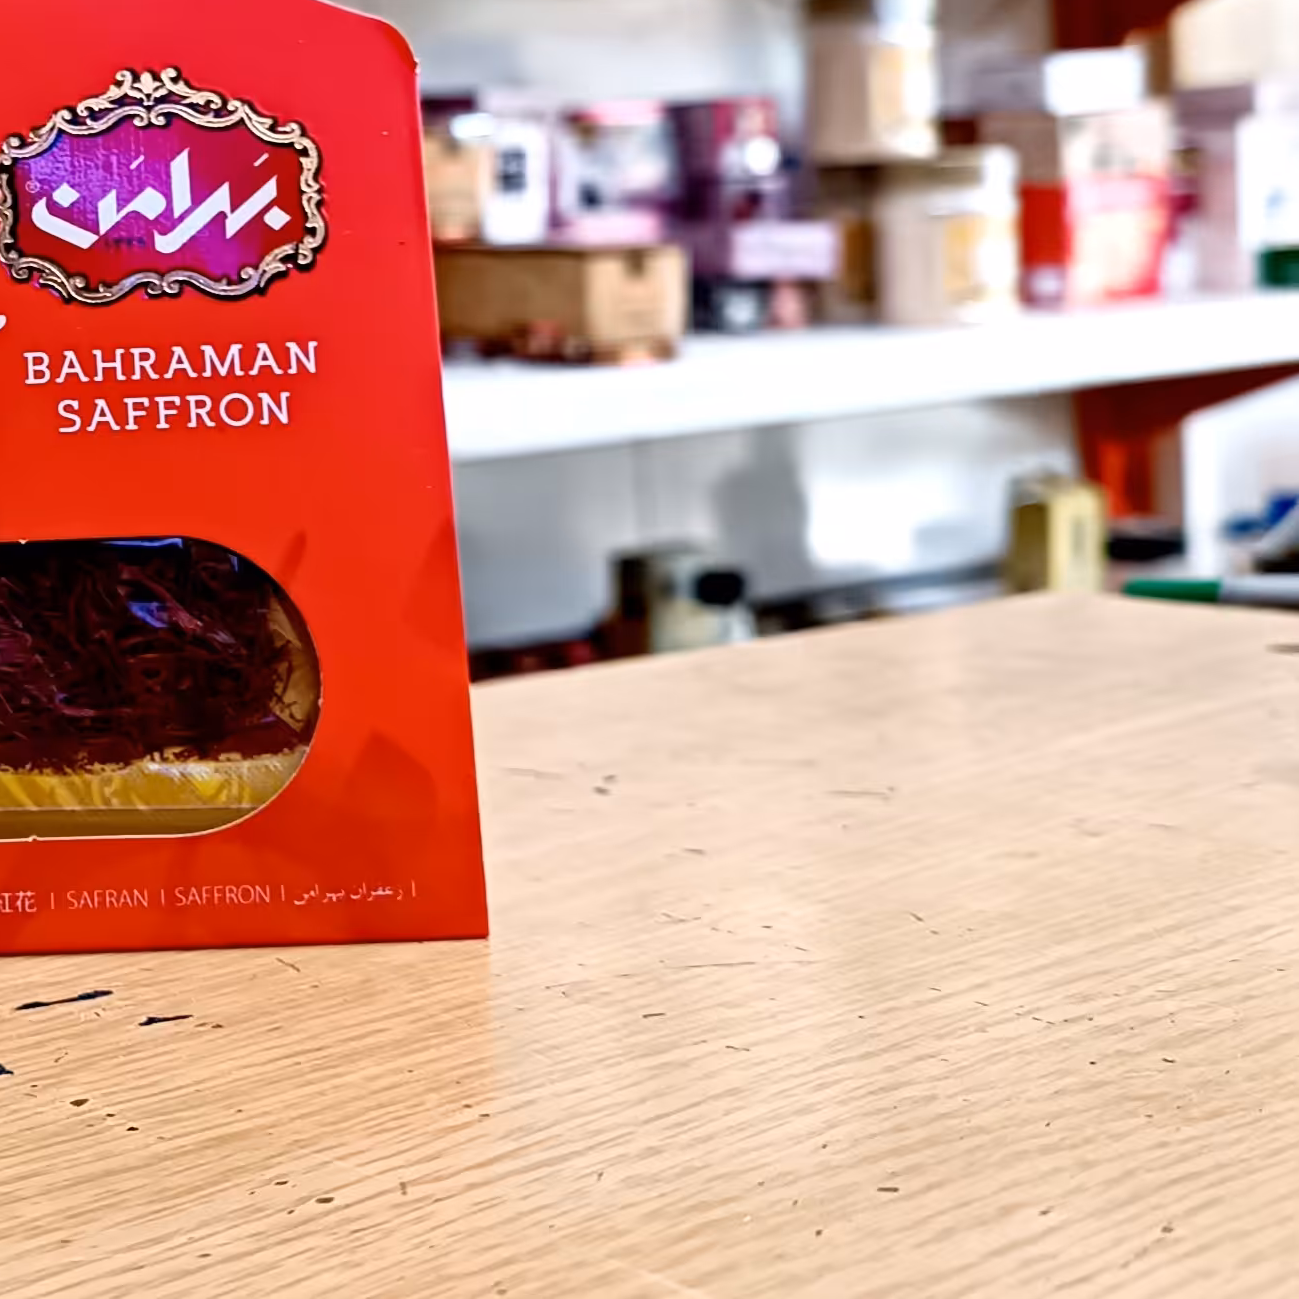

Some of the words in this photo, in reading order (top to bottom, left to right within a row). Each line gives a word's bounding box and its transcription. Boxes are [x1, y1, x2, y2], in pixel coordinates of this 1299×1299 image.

[22, 340, 319, 385] BAHRAMAN
[56, 391, 292, 434] SAFFRON
[65, 888, 149, 910] SAFRAN
[173, 884, 271, 907] SAFFRON
